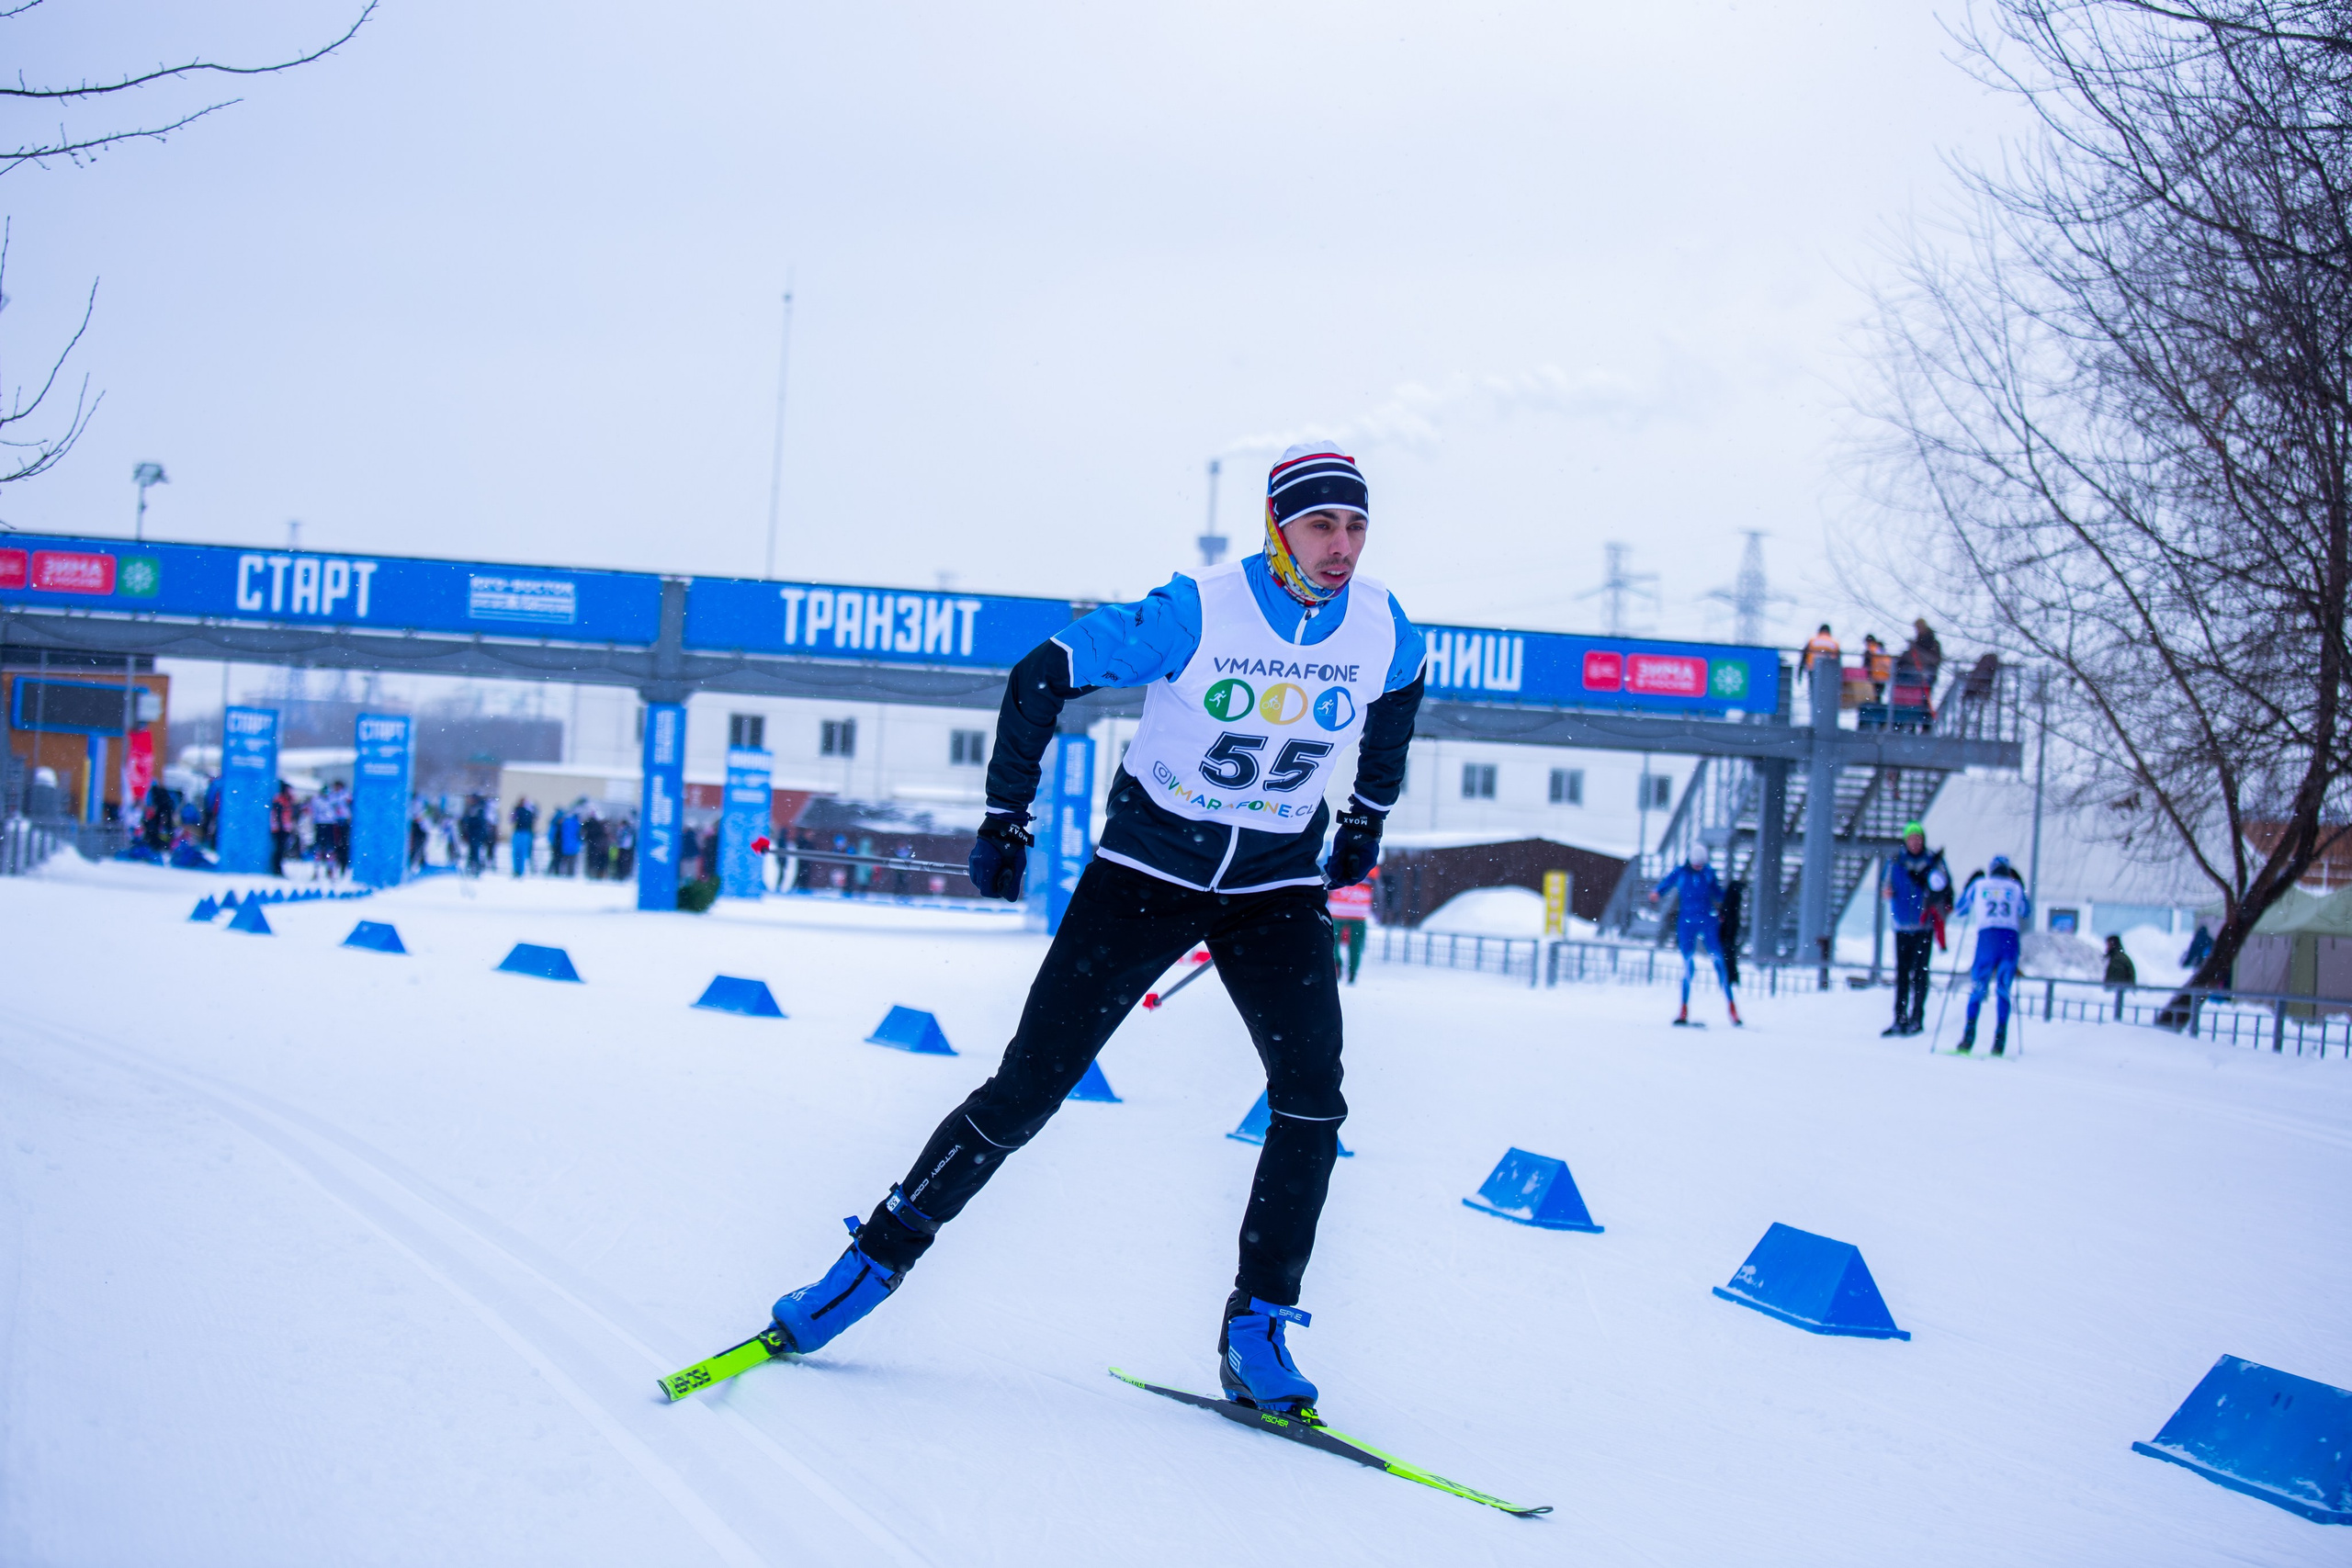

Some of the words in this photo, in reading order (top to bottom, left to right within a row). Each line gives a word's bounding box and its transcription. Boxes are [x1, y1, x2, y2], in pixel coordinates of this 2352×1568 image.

[236, 553, 379, 618] СТАРТ
[779, 587, 982, 657] ТРАНЗИТ
[1213, 656, 1361, 682] VMARAFONE
[1424, 630, 1524, 692] НИШ
[1198, 730, 1335, 793] 55
[1168, 775, 1319, 818] VMARAFONE.CL
[1008, 826, 1029, 843] MOAX
[1343, 817, 1368, 826] MOAX
[1985, 900, 2011, 918] 23
[931, 1144, 962, 1179] VICTORY
[909, 1178, 930, 1202] CODE
[1278, 1308, 1303, 1322] SPINE
[1261, 1413, 1289, 1428] FISCHER
